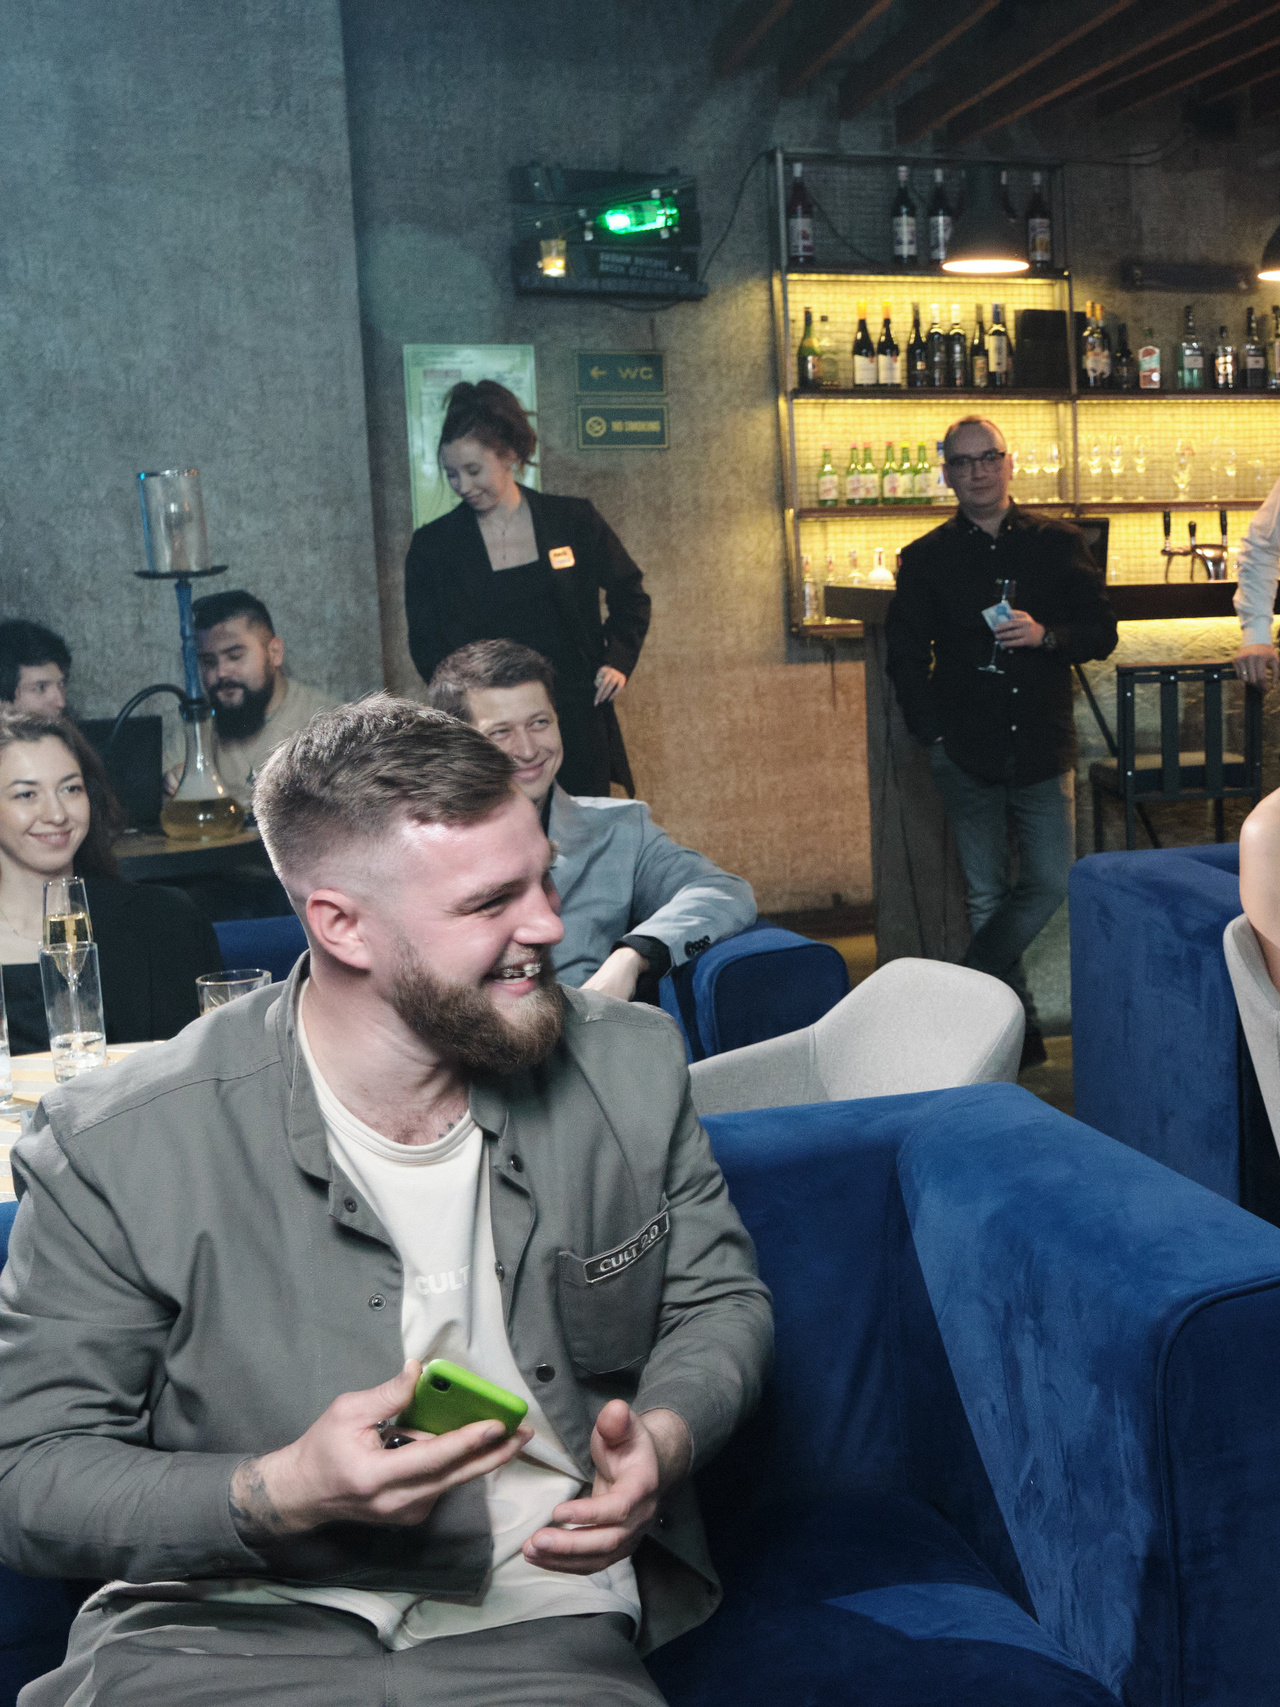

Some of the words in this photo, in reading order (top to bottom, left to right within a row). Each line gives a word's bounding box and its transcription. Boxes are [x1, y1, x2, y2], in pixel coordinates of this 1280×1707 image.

[618, 366, 653, 380] WC
[599, 1242, 639, 1272] CULT
[640, 1224, 659, 1248] 2.0
[415, 1264, 470, 1295] CULT
